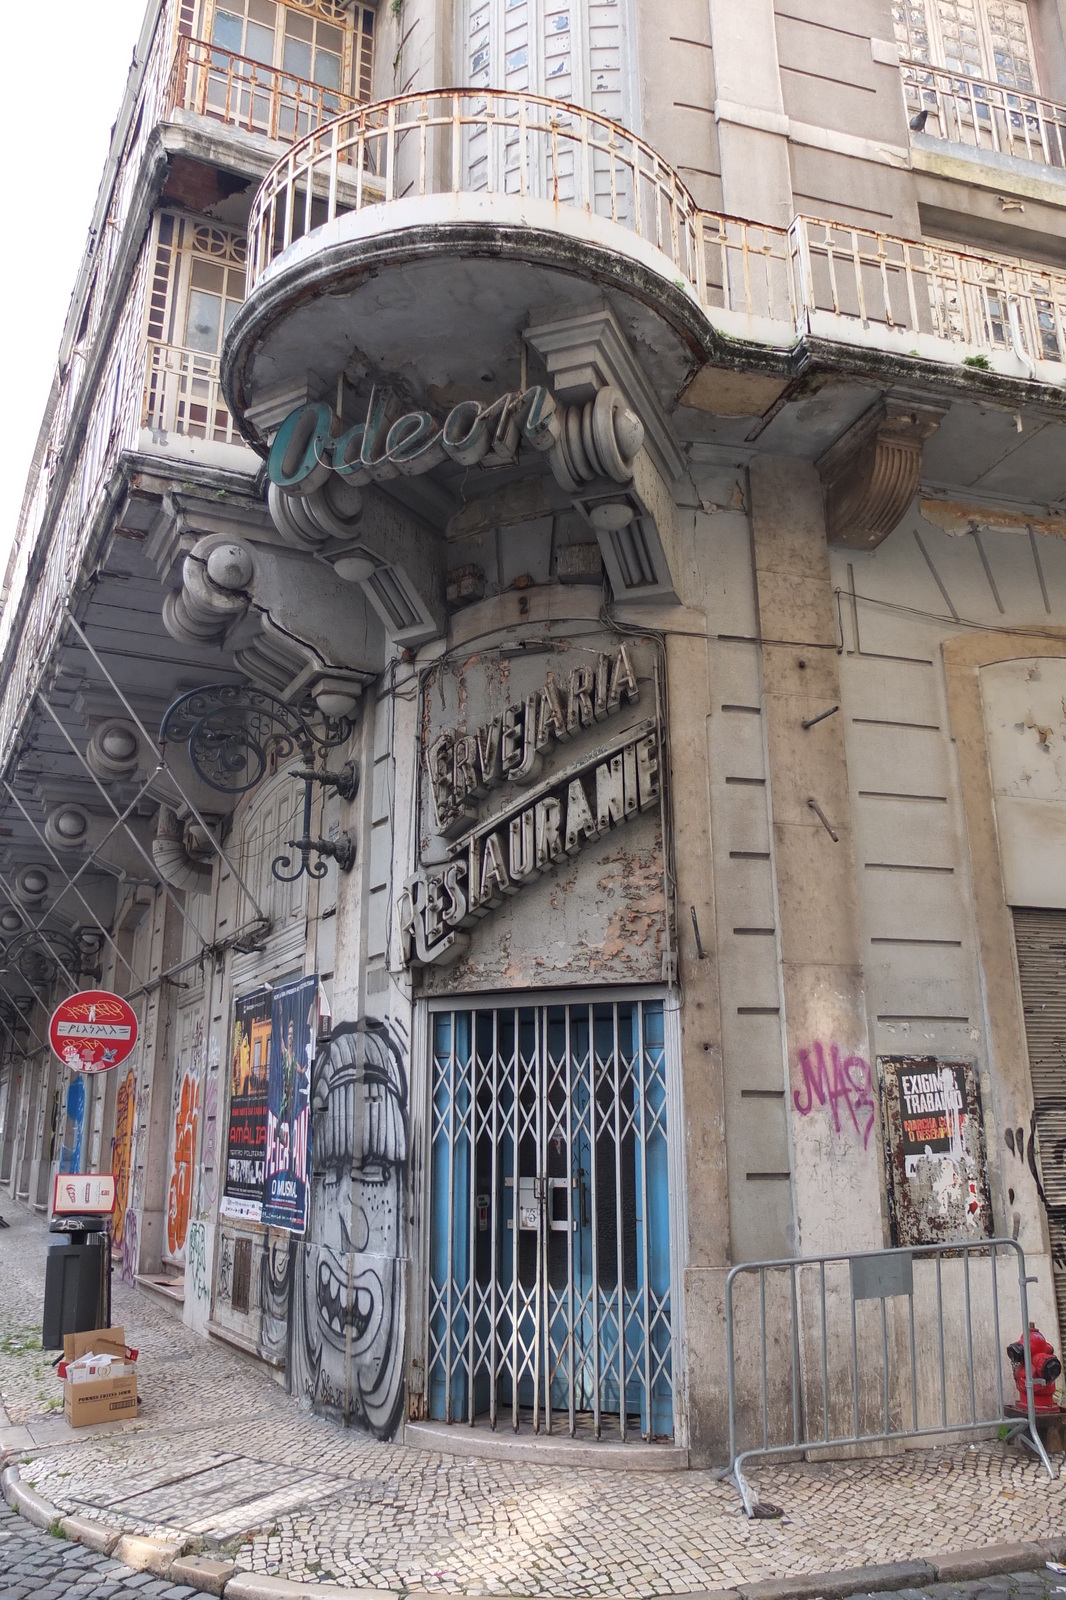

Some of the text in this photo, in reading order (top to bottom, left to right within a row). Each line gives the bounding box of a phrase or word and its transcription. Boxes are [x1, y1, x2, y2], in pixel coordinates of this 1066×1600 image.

[268, 384, 557, 492] Odeon
[518, 596, 528, 615] 2
[426, 642, 639, 837] CERVEJARIA
[397, 733, 660, 968] RESTAURANTE
[230, 1120, 267, 1145] AMÁLIA
[265, 1104, 309, 1184] PETER PAN
[271, 1179, 277, 1195] O
